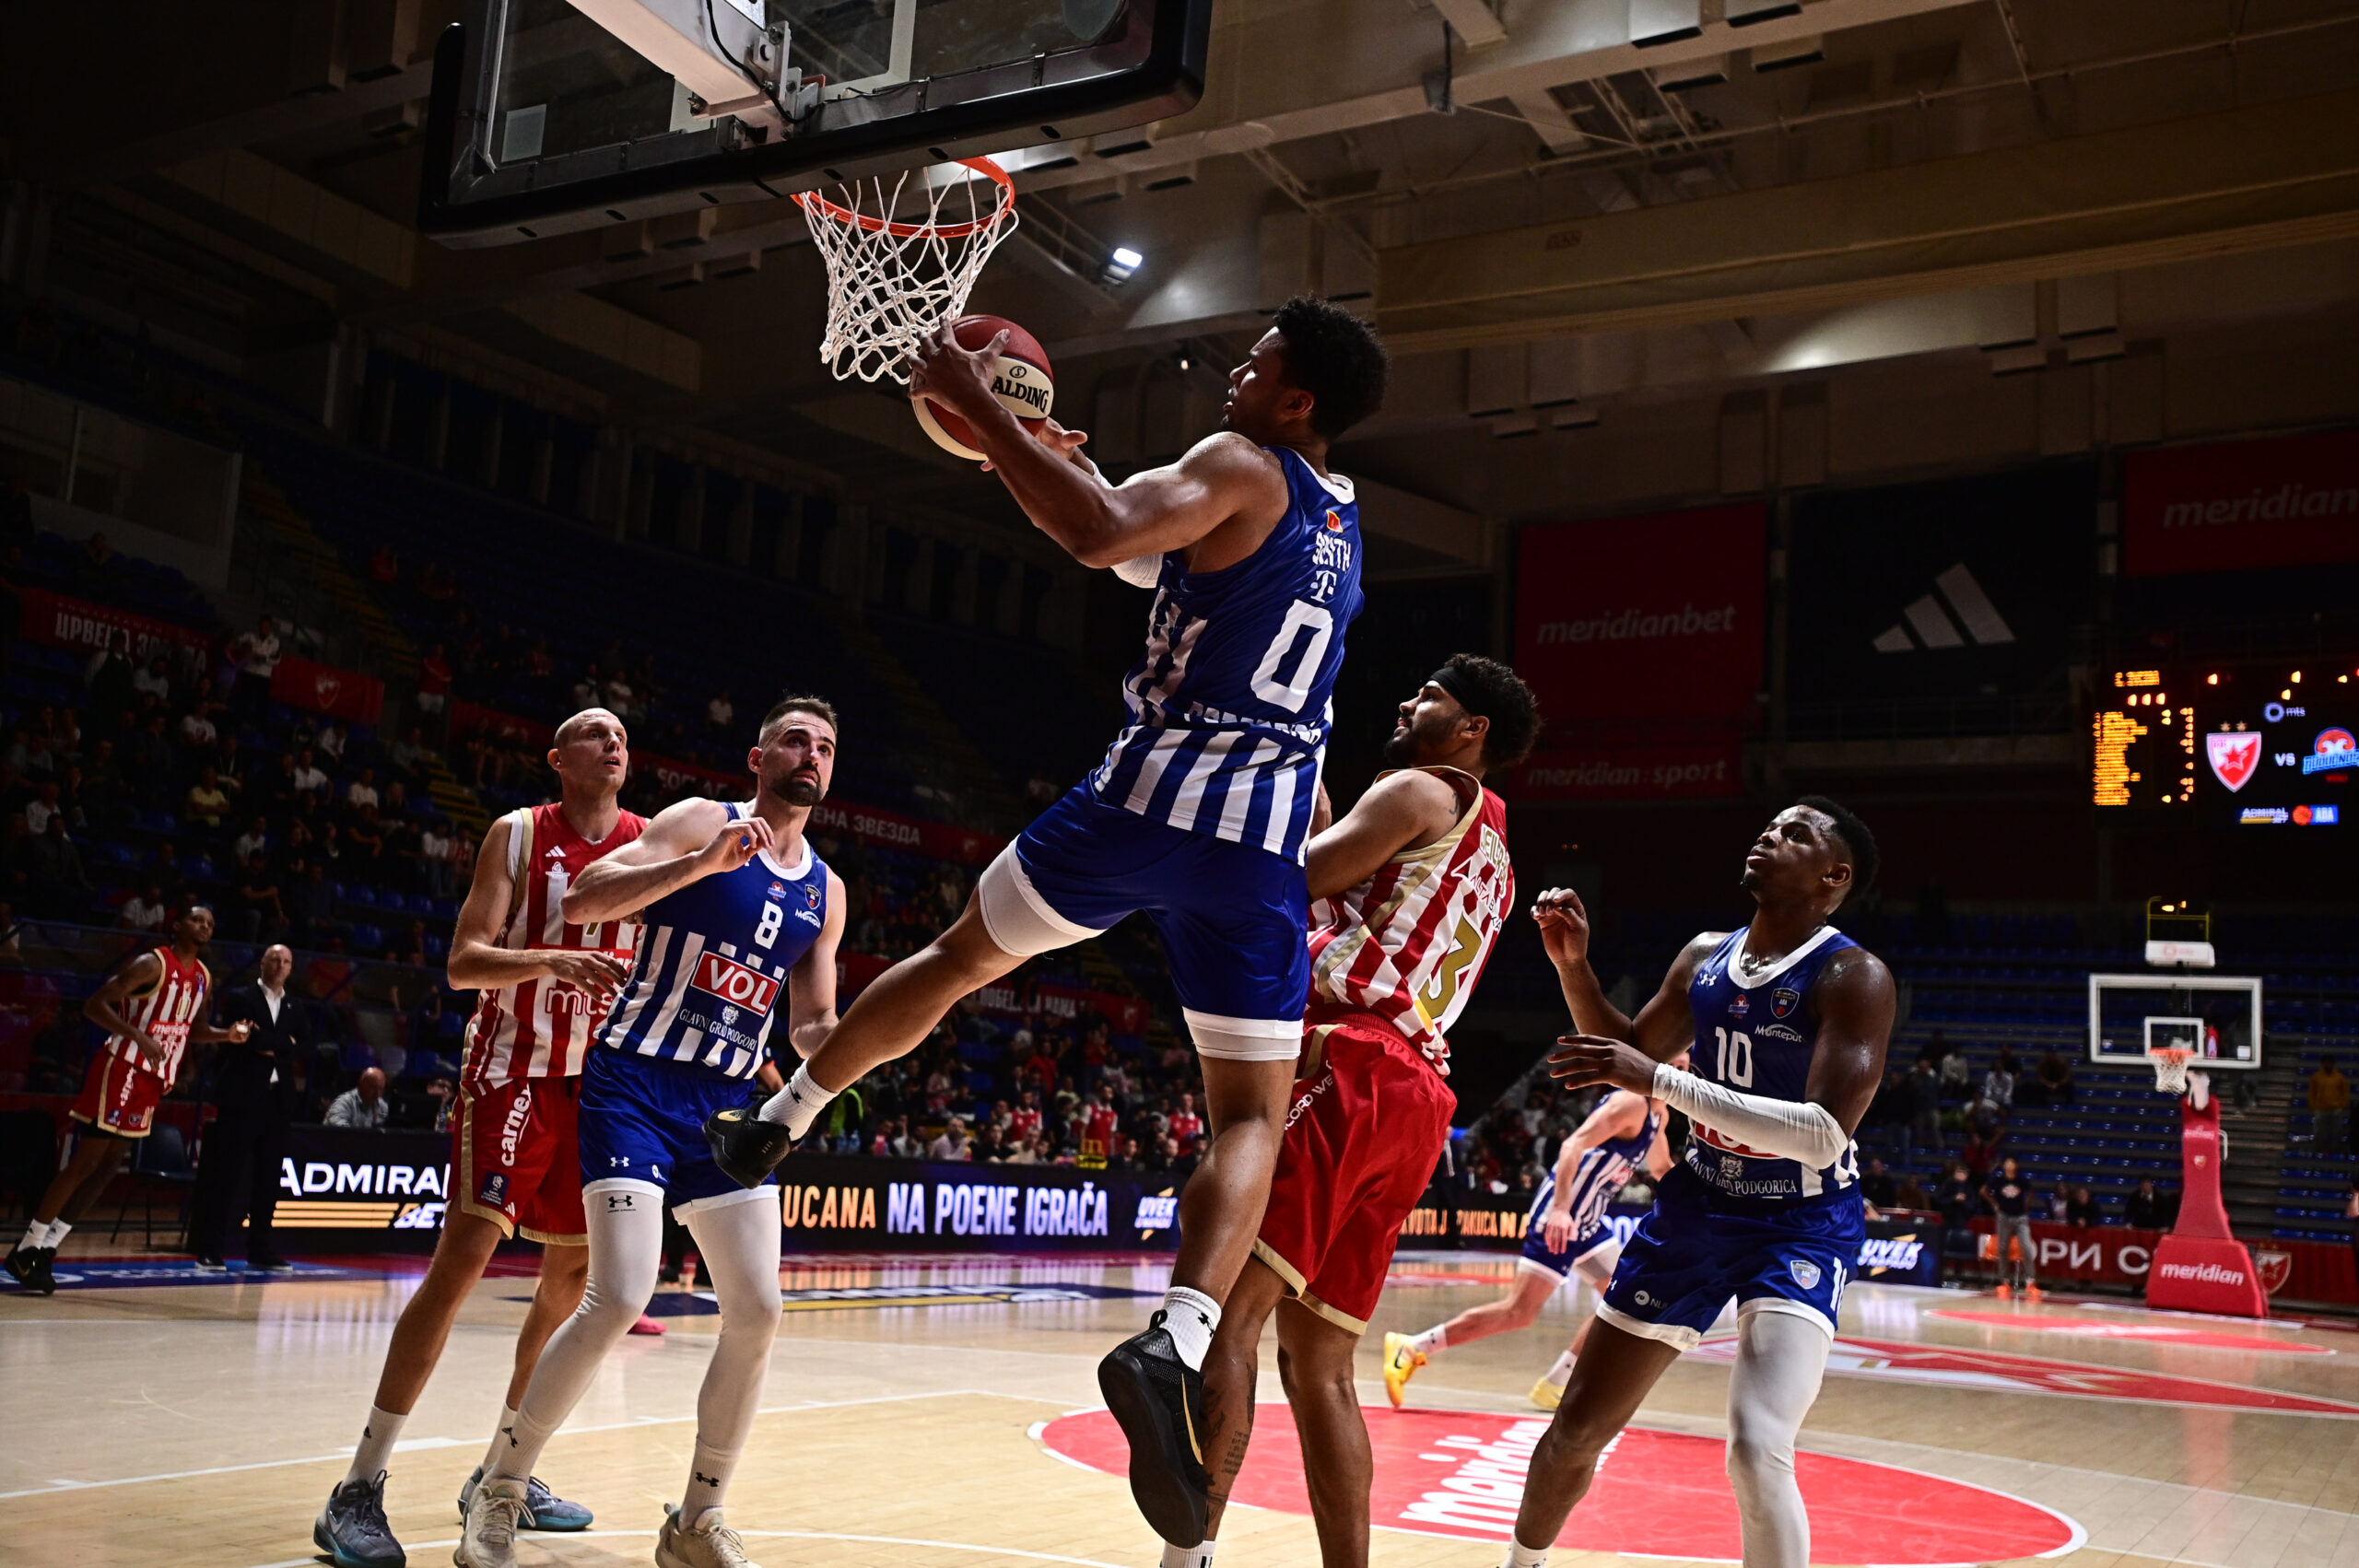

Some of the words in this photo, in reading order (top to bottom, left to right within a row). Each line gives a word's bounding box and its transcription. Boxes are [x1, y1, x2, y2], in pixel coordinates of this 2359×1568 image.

[991, 375, 1049, 415] ALDING
[1536, 601, 1738, 646] meridianbet
[1250, 599, 1333, 714] 0
[1527, 761, 1640, 788] meridian
[1650, 758, 1726, 790] sport
[809, 803, 849, 828] ЕНА
[853, 813, 921, 846] ЗВЕЗДА
[754, 899, 783, 950] 8
[679, 1008, 711, 1029] GLAVNI
[726, 1026, 757, 1051] PODGORI
[1755, 1024, 1803, 1043] Monteput
[1715, 1026, 1753, 1088] 10
[778, 1184, 876, 1229] UCANA
[887, 1182, 924, 1235] NA
[934, 1183, 1016, 1236] POENE
[1024, 1181, 1109, 1236] IGRAČA
[1735, 1179, 1797, 1195] PODGORICA
[2160, 1263, 2245, 1287] meridian
